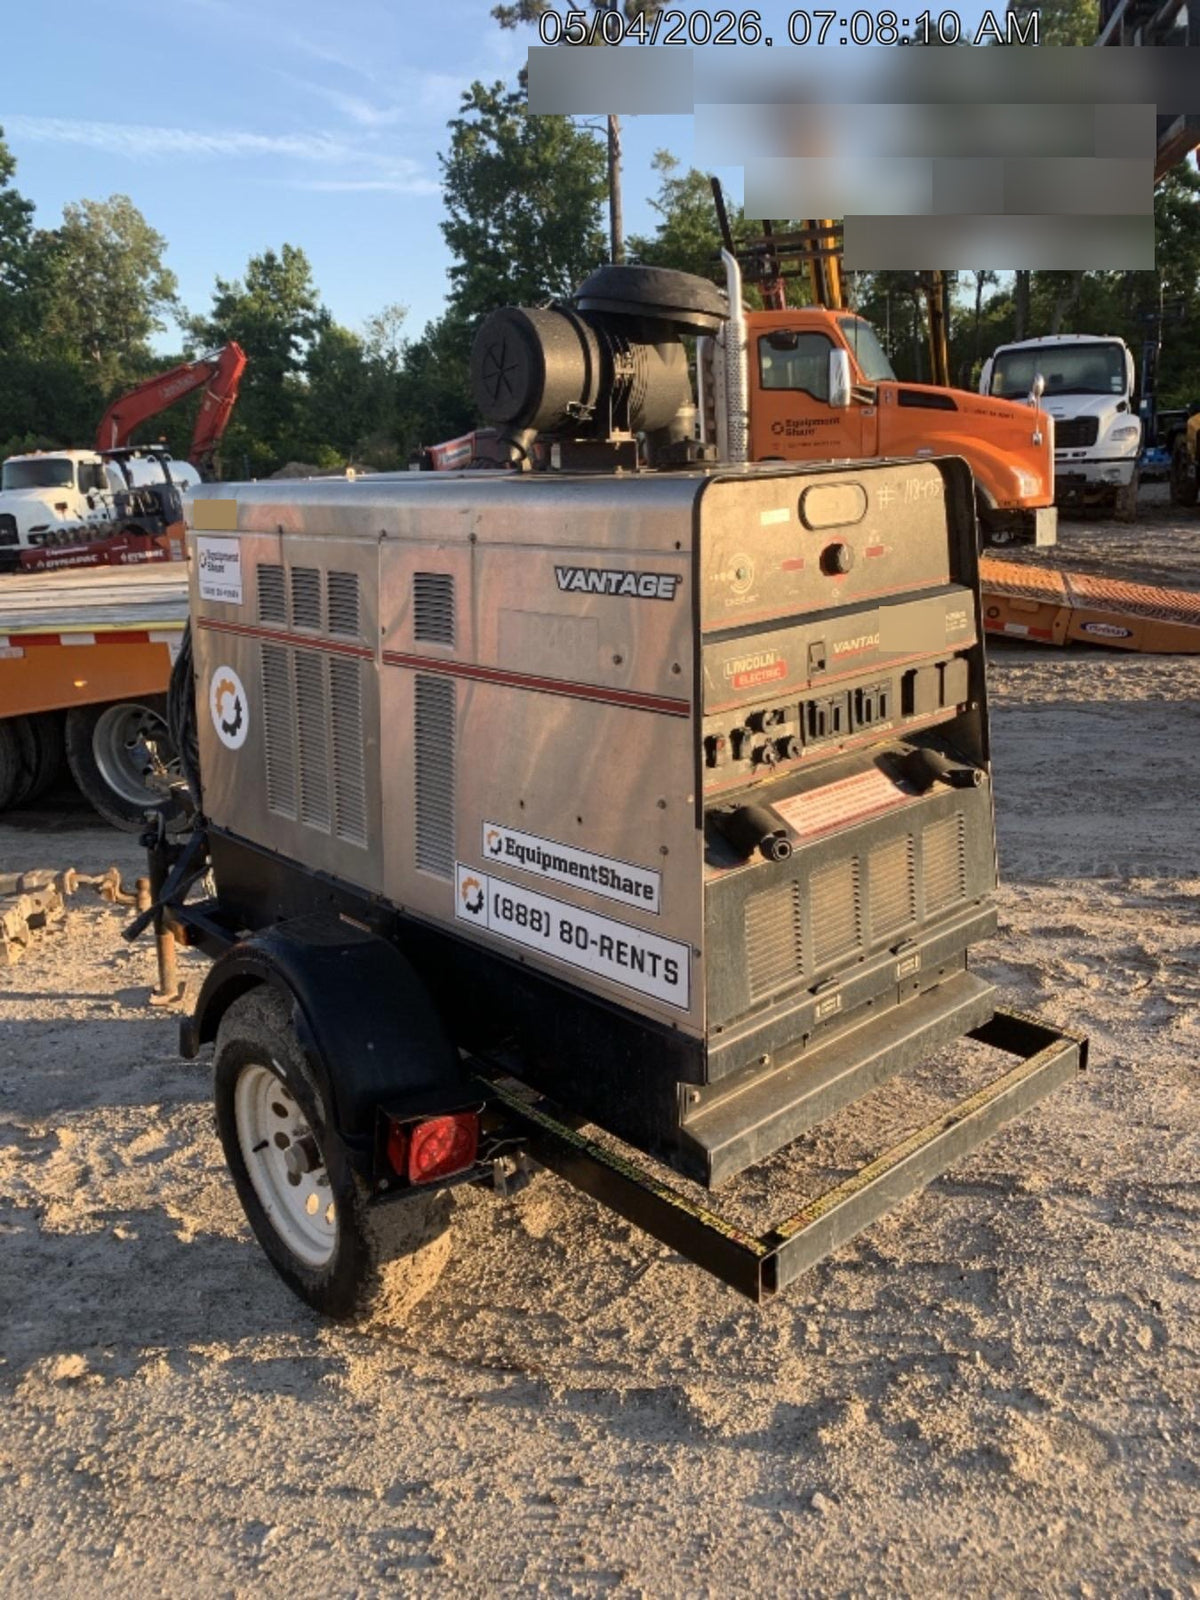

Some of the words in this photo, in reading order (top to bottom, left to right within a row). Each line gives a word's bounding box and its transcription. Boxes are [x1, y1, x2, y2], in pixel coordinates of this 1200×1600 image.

[554, 566, 678, 601] VANTAGE
[726, 652, 775, 676] LINCOLN
[739, 666, 781, 686] ELECTRIC
[505, 836, 654, 901] EquipmentShare
[494, 893, 550, 938] (888)
[559, 920, 679, 986] 80-RENTS
